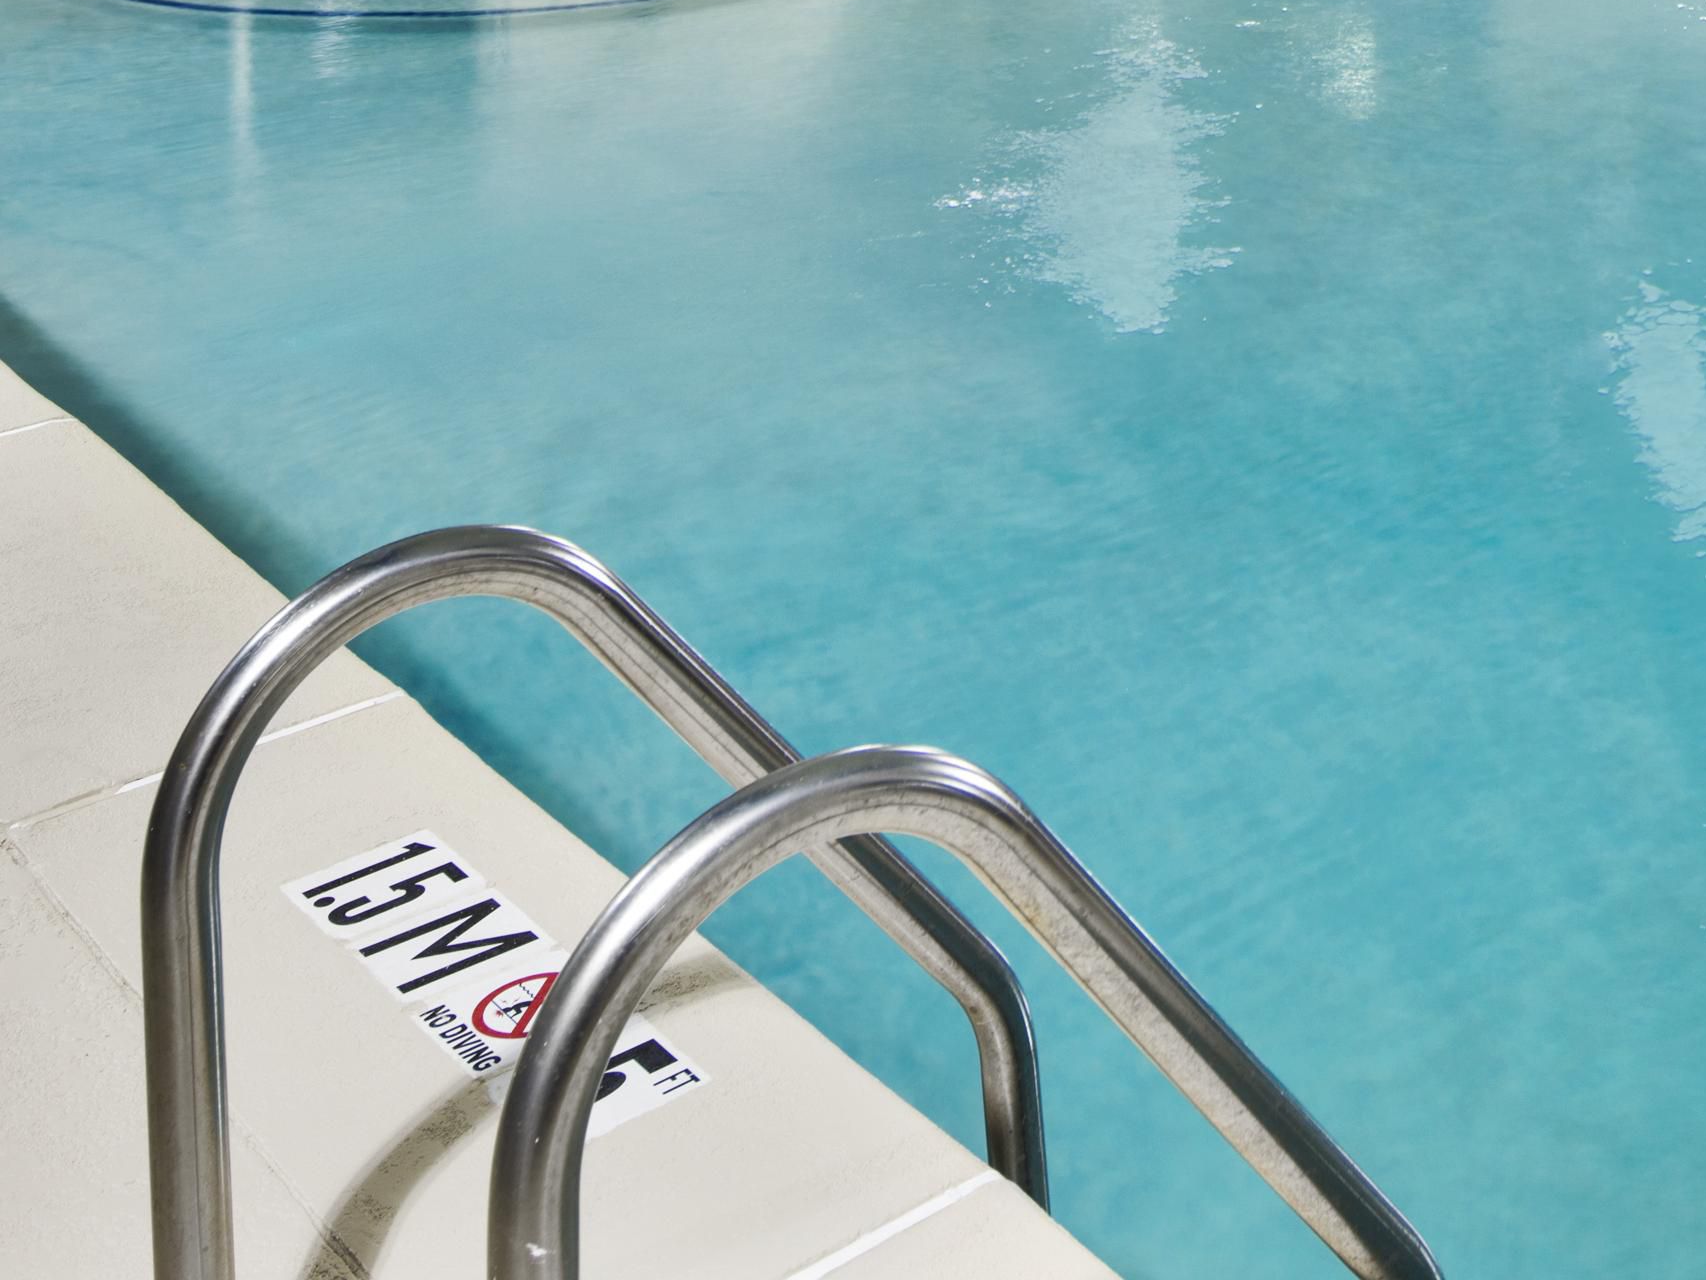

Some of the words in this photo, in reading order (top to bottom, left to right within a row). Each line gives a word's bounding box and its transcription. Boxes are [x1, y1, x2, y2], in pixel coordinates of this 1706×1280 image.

[302, 842, 469, 926] 1.5
[358, 898, 539, 994] M
[419, 1004, 459, 1029] NO
[438, 1023, 502, 1072] DIVING
[652, 1068, 701, 1095] FT
